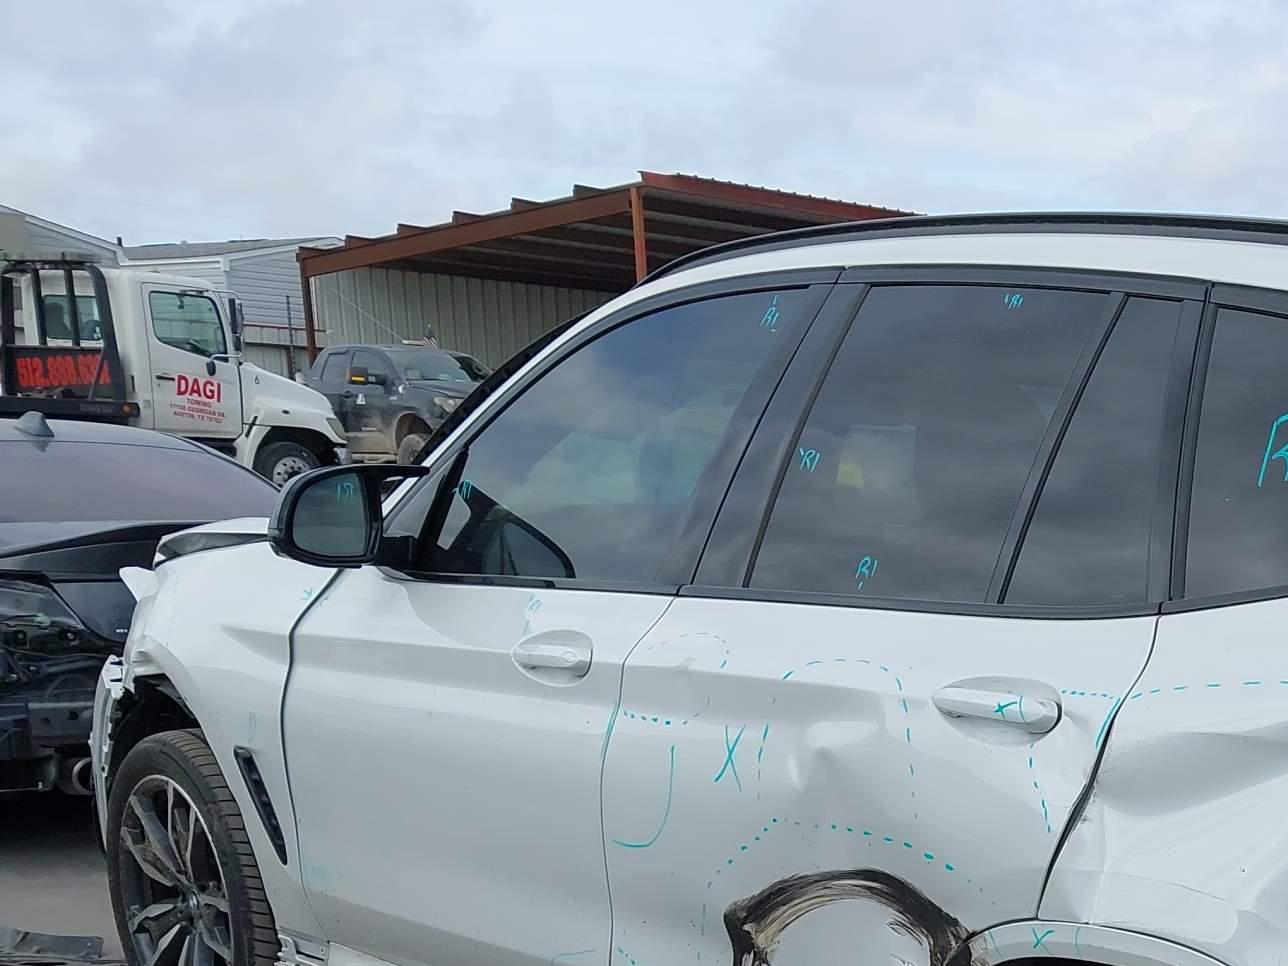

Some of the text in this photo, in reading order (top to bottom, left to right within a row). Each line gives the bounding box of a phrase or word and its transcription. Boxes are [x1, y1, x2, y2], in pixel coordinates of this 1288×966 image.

[254, 375, 261, 385] 6
[175, 373, 222, 404] DAGI
[186, 397, 213, 409] TOWING
